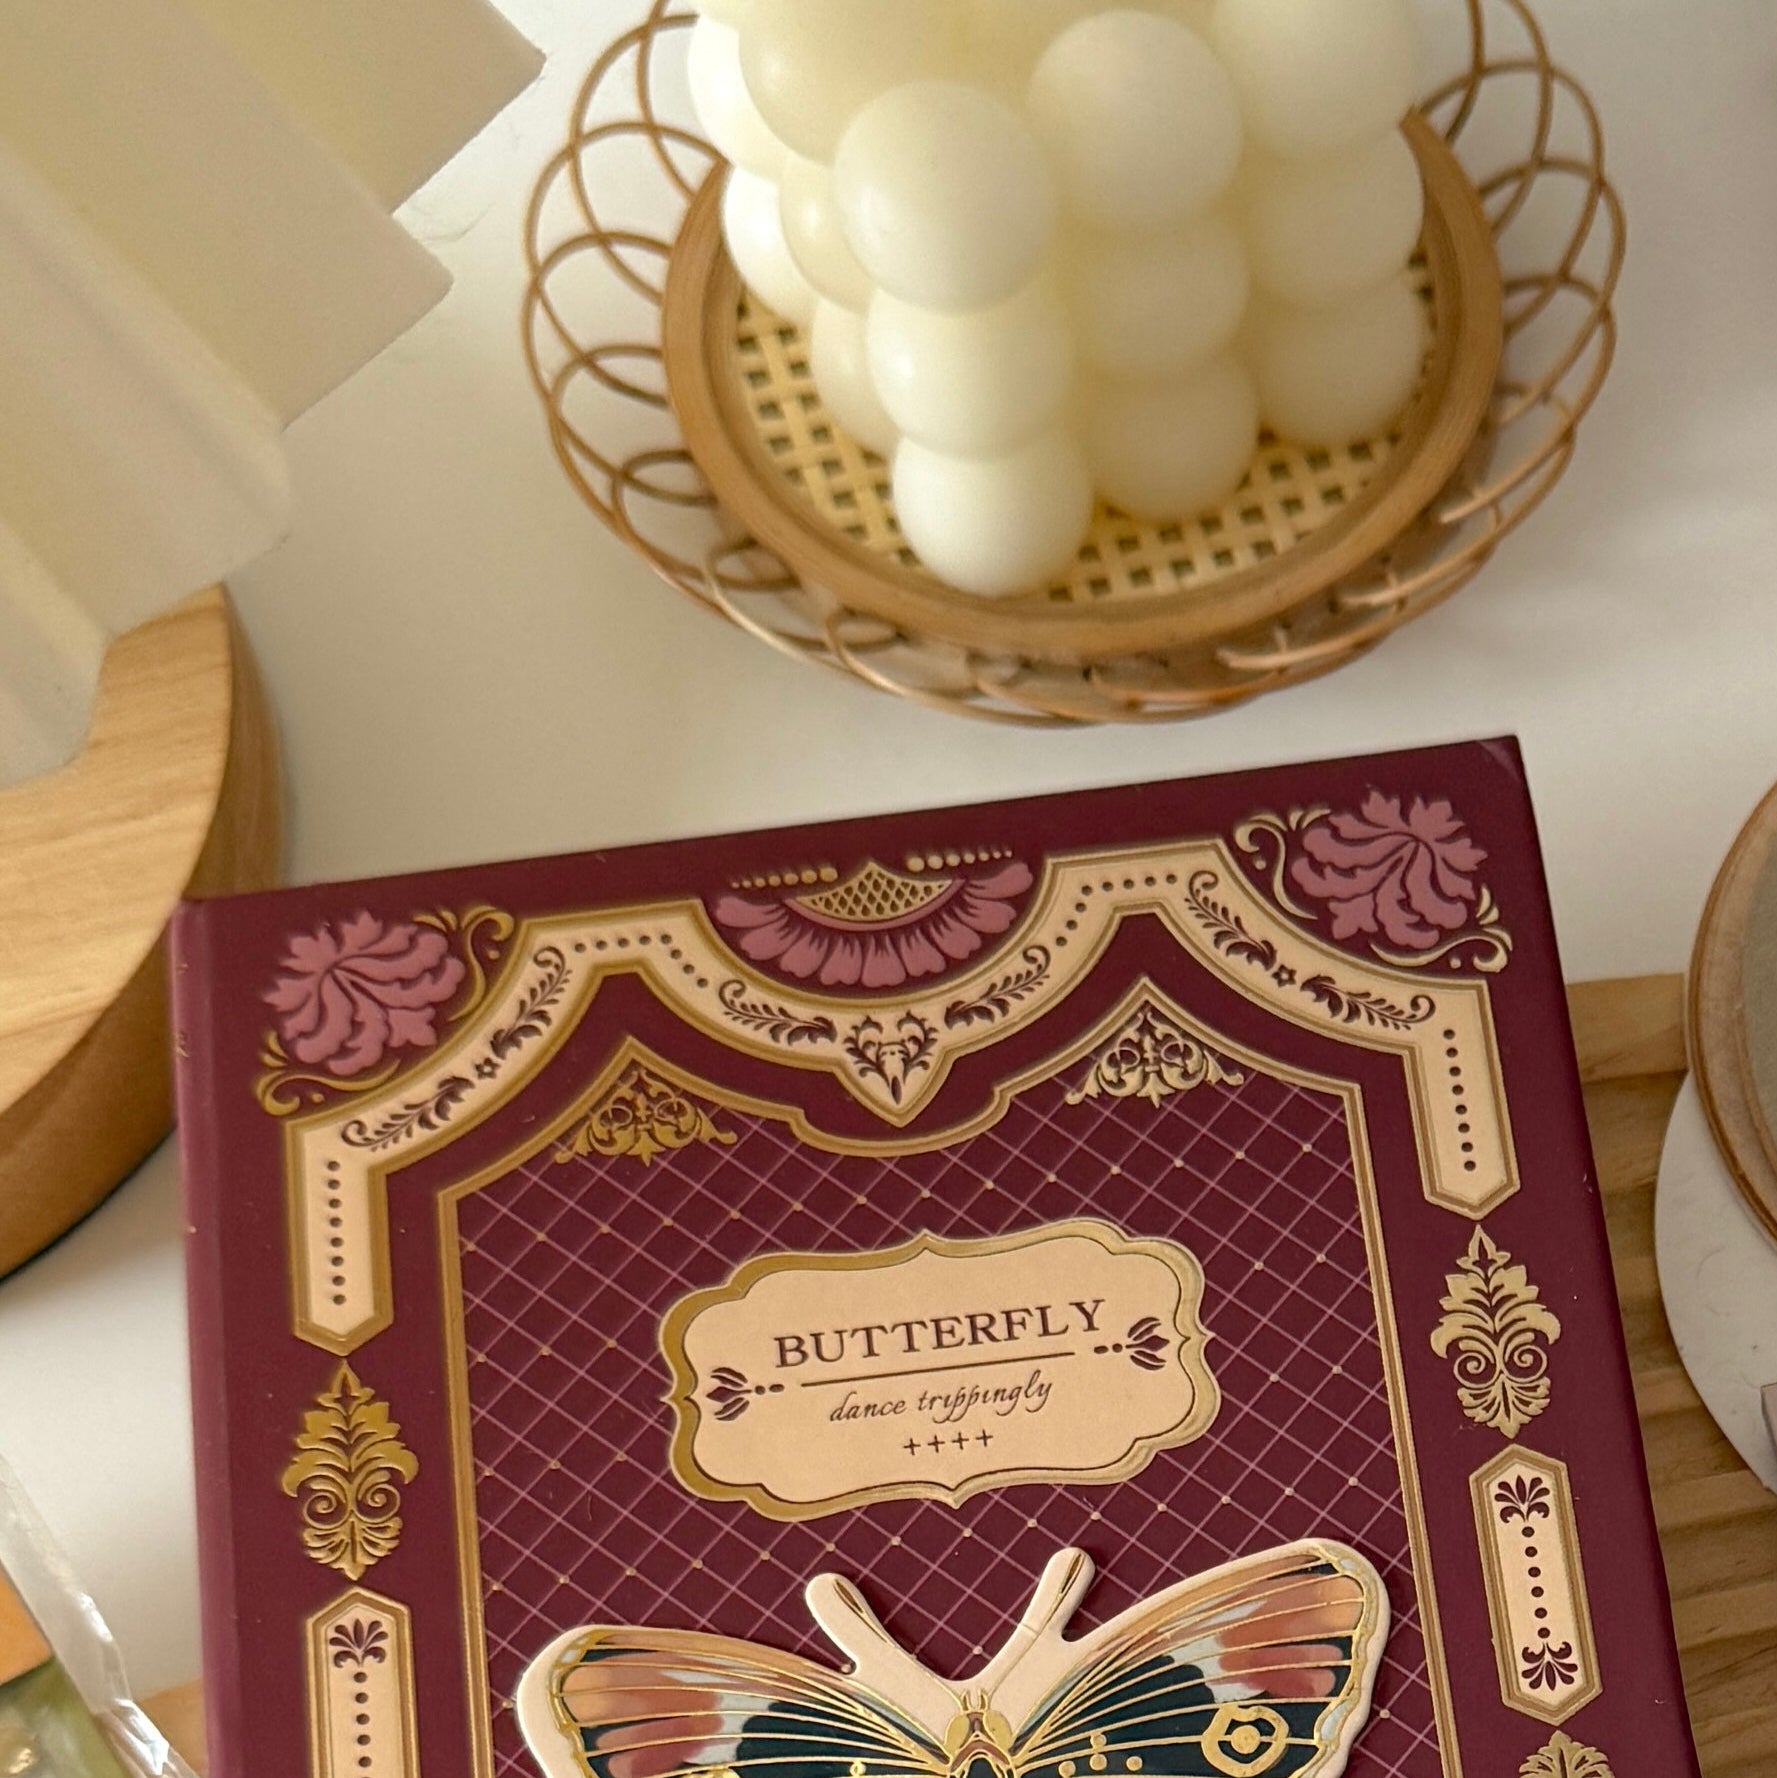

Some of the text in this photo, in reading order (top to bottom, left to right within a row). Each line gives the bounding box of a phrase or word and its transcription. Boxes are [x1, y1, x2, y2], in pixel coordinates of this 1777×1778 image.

[774, 1298, 1106, 1369] BUTTERFLY
[829, 1370, 1053, 1423] dance trippingly
